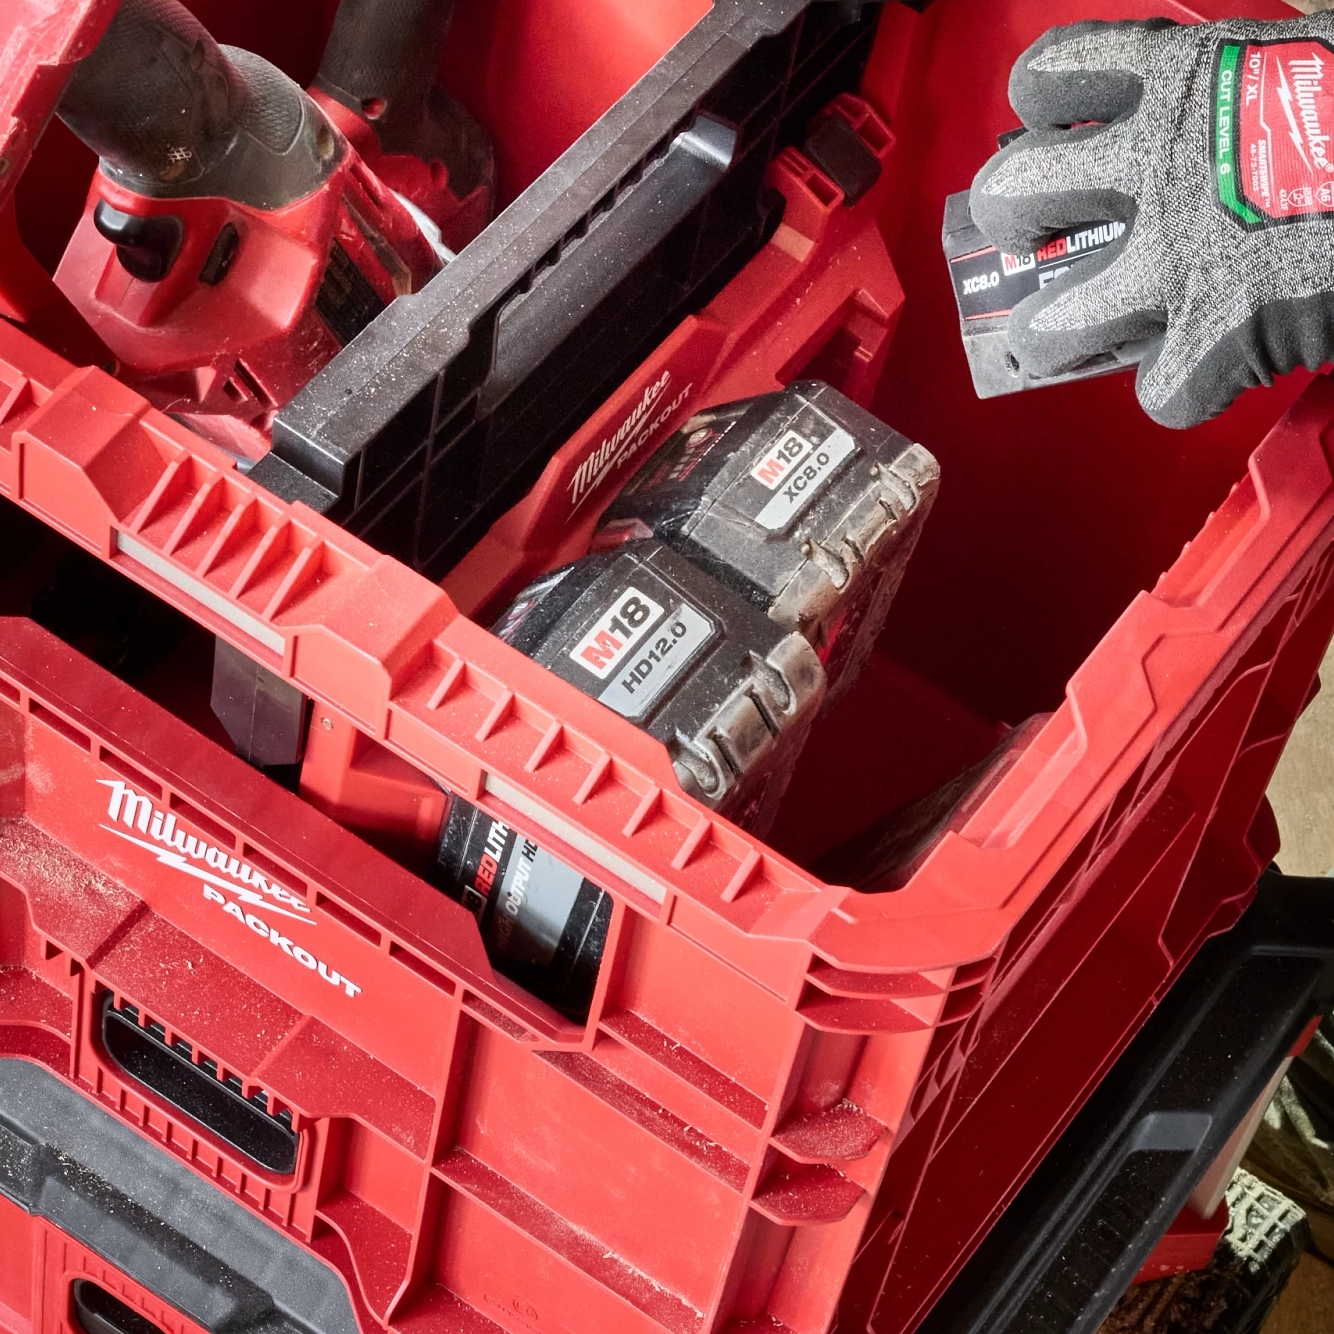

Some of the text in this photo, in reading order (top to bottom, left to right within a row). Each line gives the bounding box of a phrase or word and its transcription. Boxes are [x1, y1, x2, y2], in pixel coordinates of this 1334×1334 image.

[1218, 70, 1233, 175] CUT LEVEL 6
[1245, 83, 1258, 106] XL
[1319, 188, 1331, 202] A6
[1036, 222, 1127, 262] REDLITHIUM
[963, 272, 1000, 295] XC8.0
[567, 371, 670, 504] Milwaukee
[617, 383, 693, 470] PACKOUT
[757, 436, 805, 486] M18
[783, 452, 830, 505] XC8.0
[580, 596, 652, 670] M18
[621, 621, 687, 694] HD12.0
[96, 779, 311, 913] Milwaukee
[505, 856, 533, 916] OUTPUT
[203, 883, 362, 997] PACKOUT
